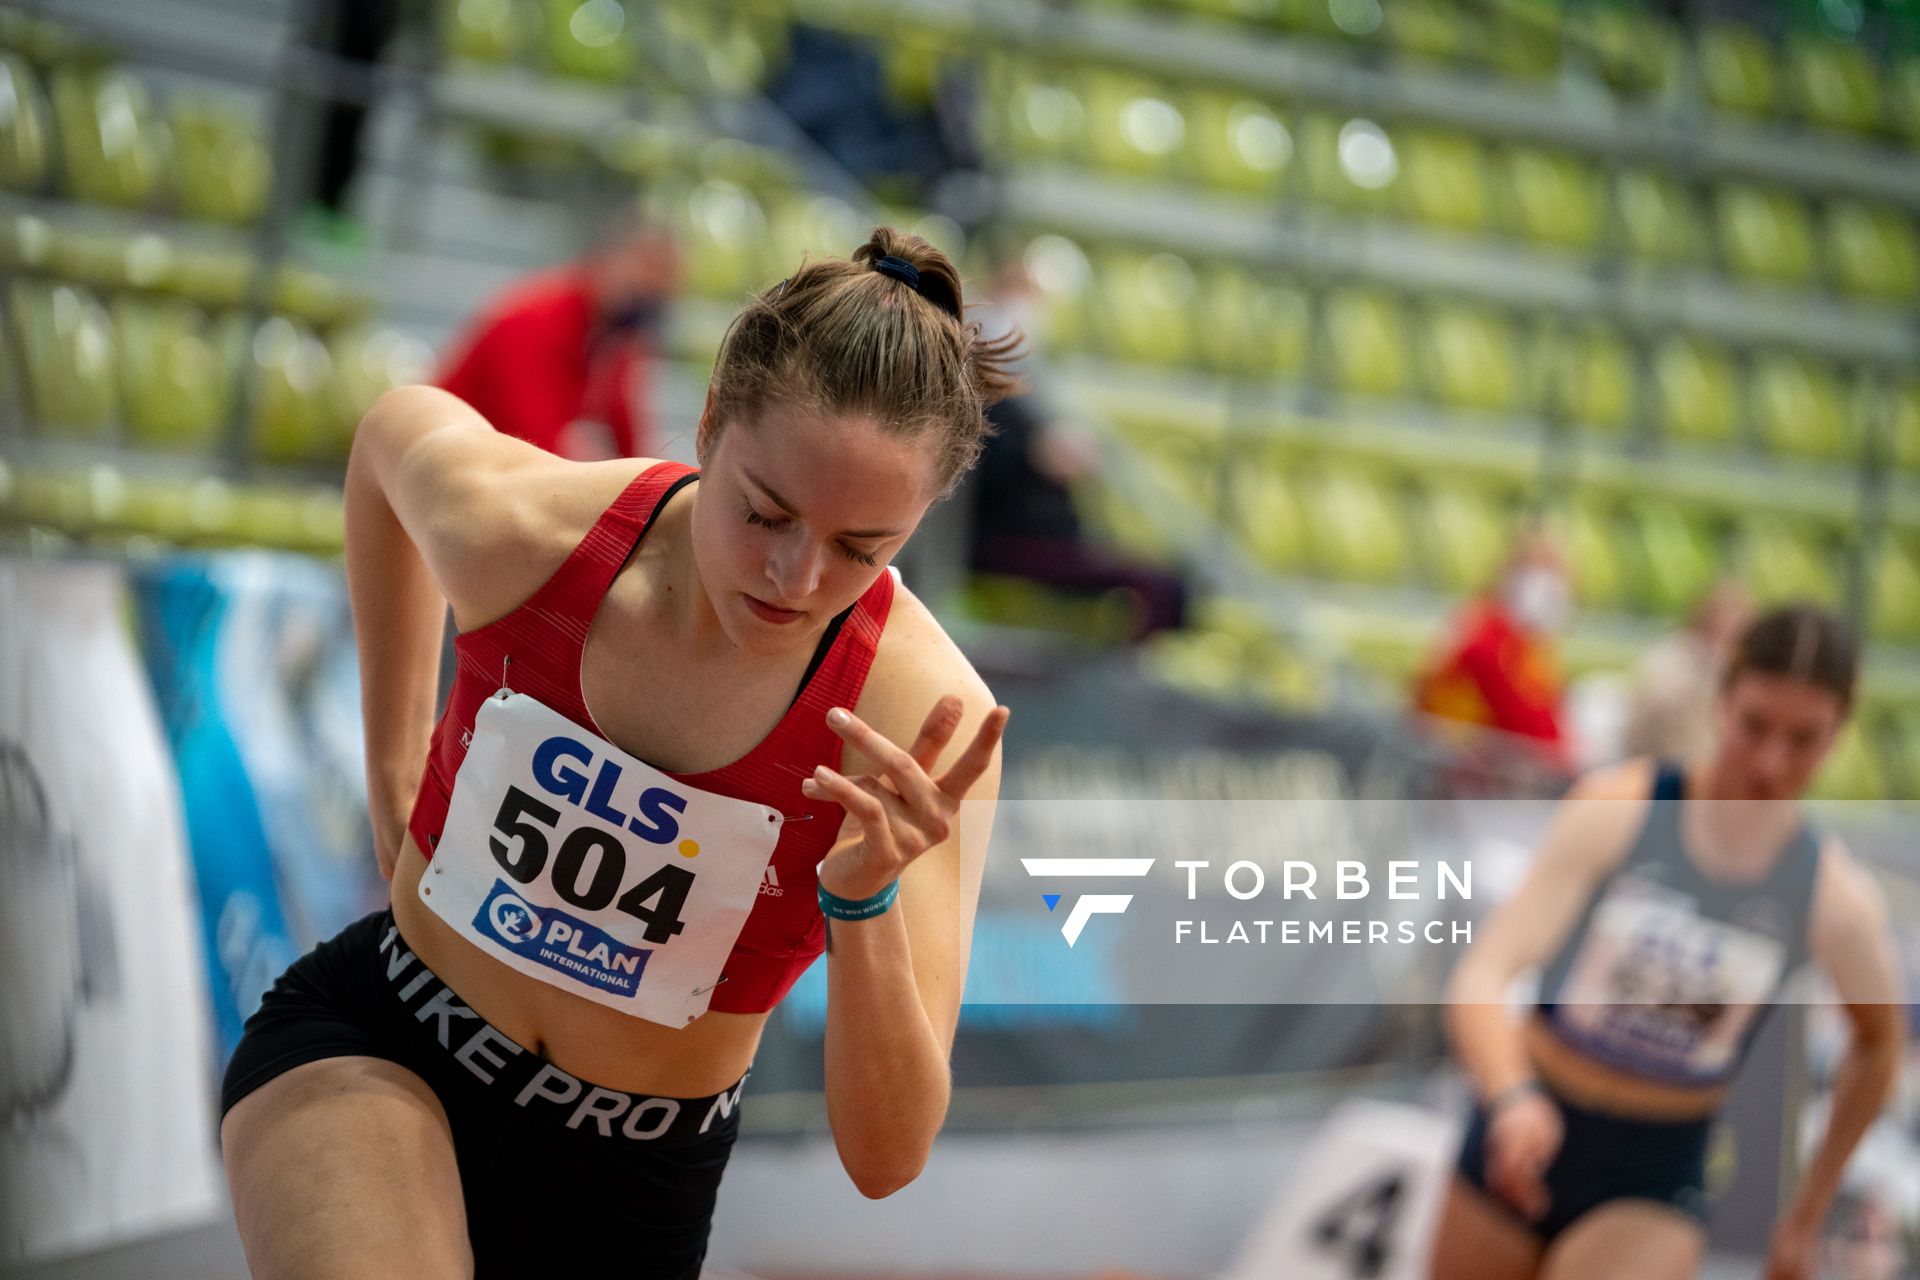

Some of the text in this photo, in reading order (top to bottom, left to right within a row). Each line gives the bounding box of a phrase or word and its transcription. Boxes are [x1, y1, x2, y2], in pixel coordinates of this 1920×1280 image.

[489, 784, 697, 945] 504
[758, 883, 784, 897] das
[539, 947, 630, 989] INTERNATIONAL
[544, 921, 641, 975] PLAN
[379, 925, 523, 1086] NIKE
[513, 1063, 681, 1141] PRO
